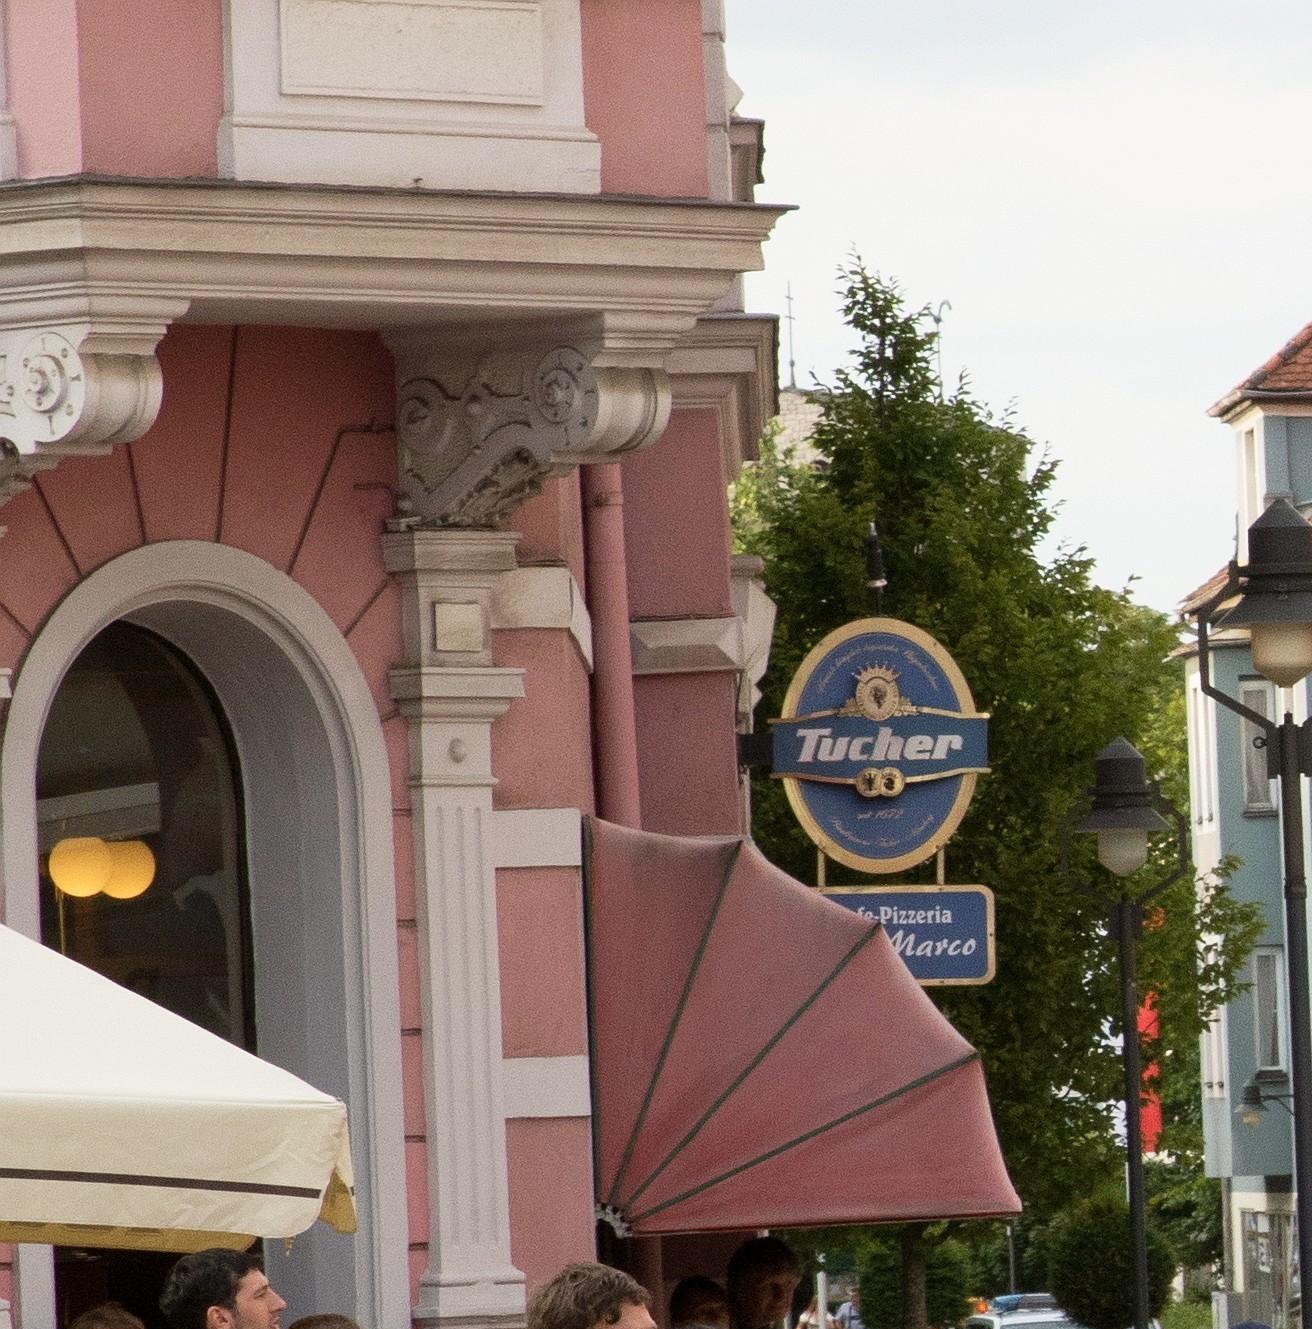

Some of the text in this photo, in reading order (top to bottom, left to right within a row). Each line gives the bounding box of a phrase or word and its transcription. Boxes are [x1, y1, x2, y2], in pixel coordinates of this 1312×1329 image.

[796, 726, 963, 763] Tucher
[857, 906, 952, 924] fe-Pizzeria
[890, 929, 977, 957] Marco
